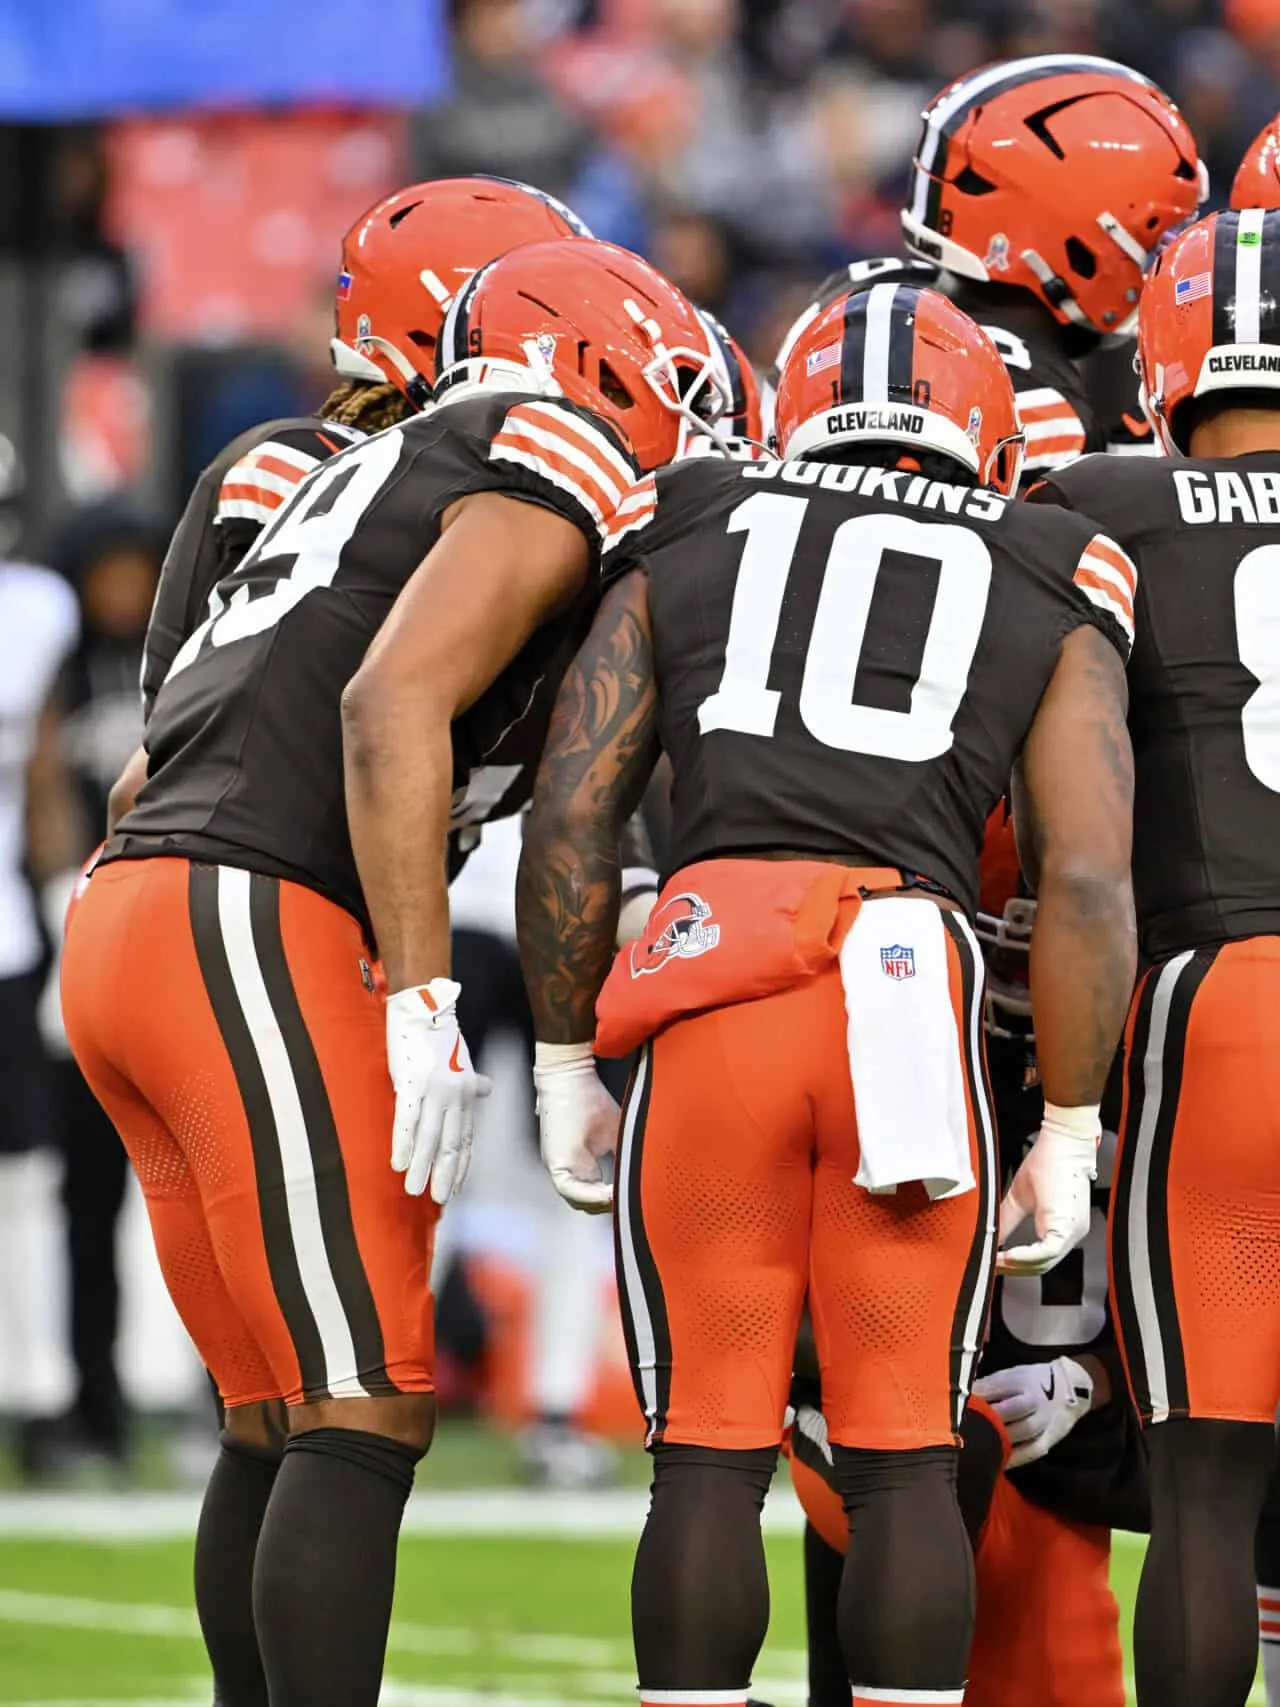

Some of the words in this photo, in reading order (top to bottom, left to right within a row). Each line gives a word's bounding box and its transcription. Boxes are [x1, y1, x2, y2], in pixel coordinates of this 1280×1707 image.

[827, 411, 924, 434] CLEVELAND
[697, 491, 993, 763] 10
[884, 959, 913, 977] NFL
